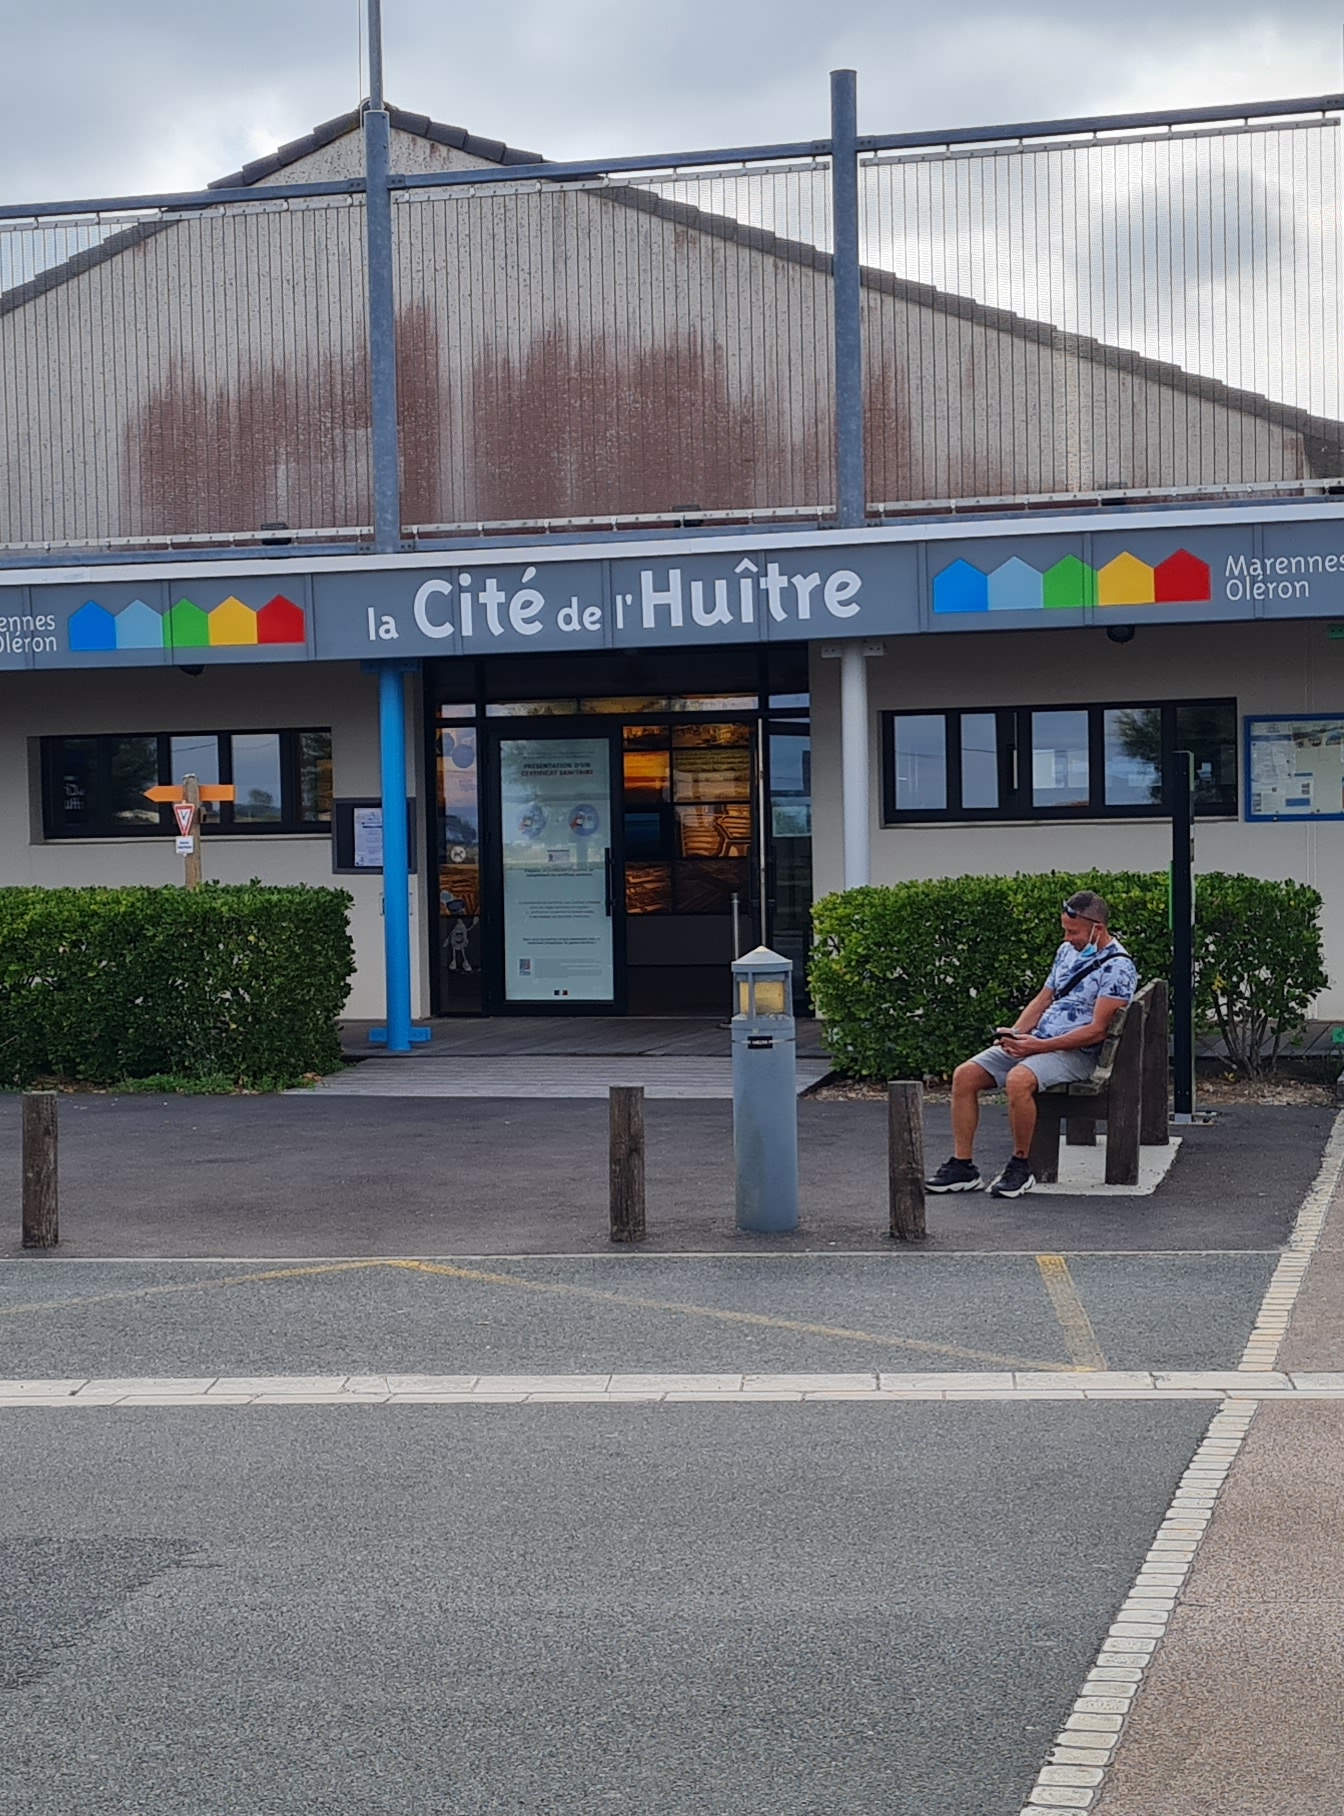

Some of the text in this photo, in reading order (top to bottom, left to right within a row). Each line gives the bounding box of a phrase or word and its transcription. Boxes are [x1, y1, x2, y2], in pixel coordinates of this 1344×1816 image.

[366, 606, 400, 641] la
[412, 566, 546, 639] Cité
[556, 596, 602, 633] de
[1225, 574, 1310, 601] Oléron
